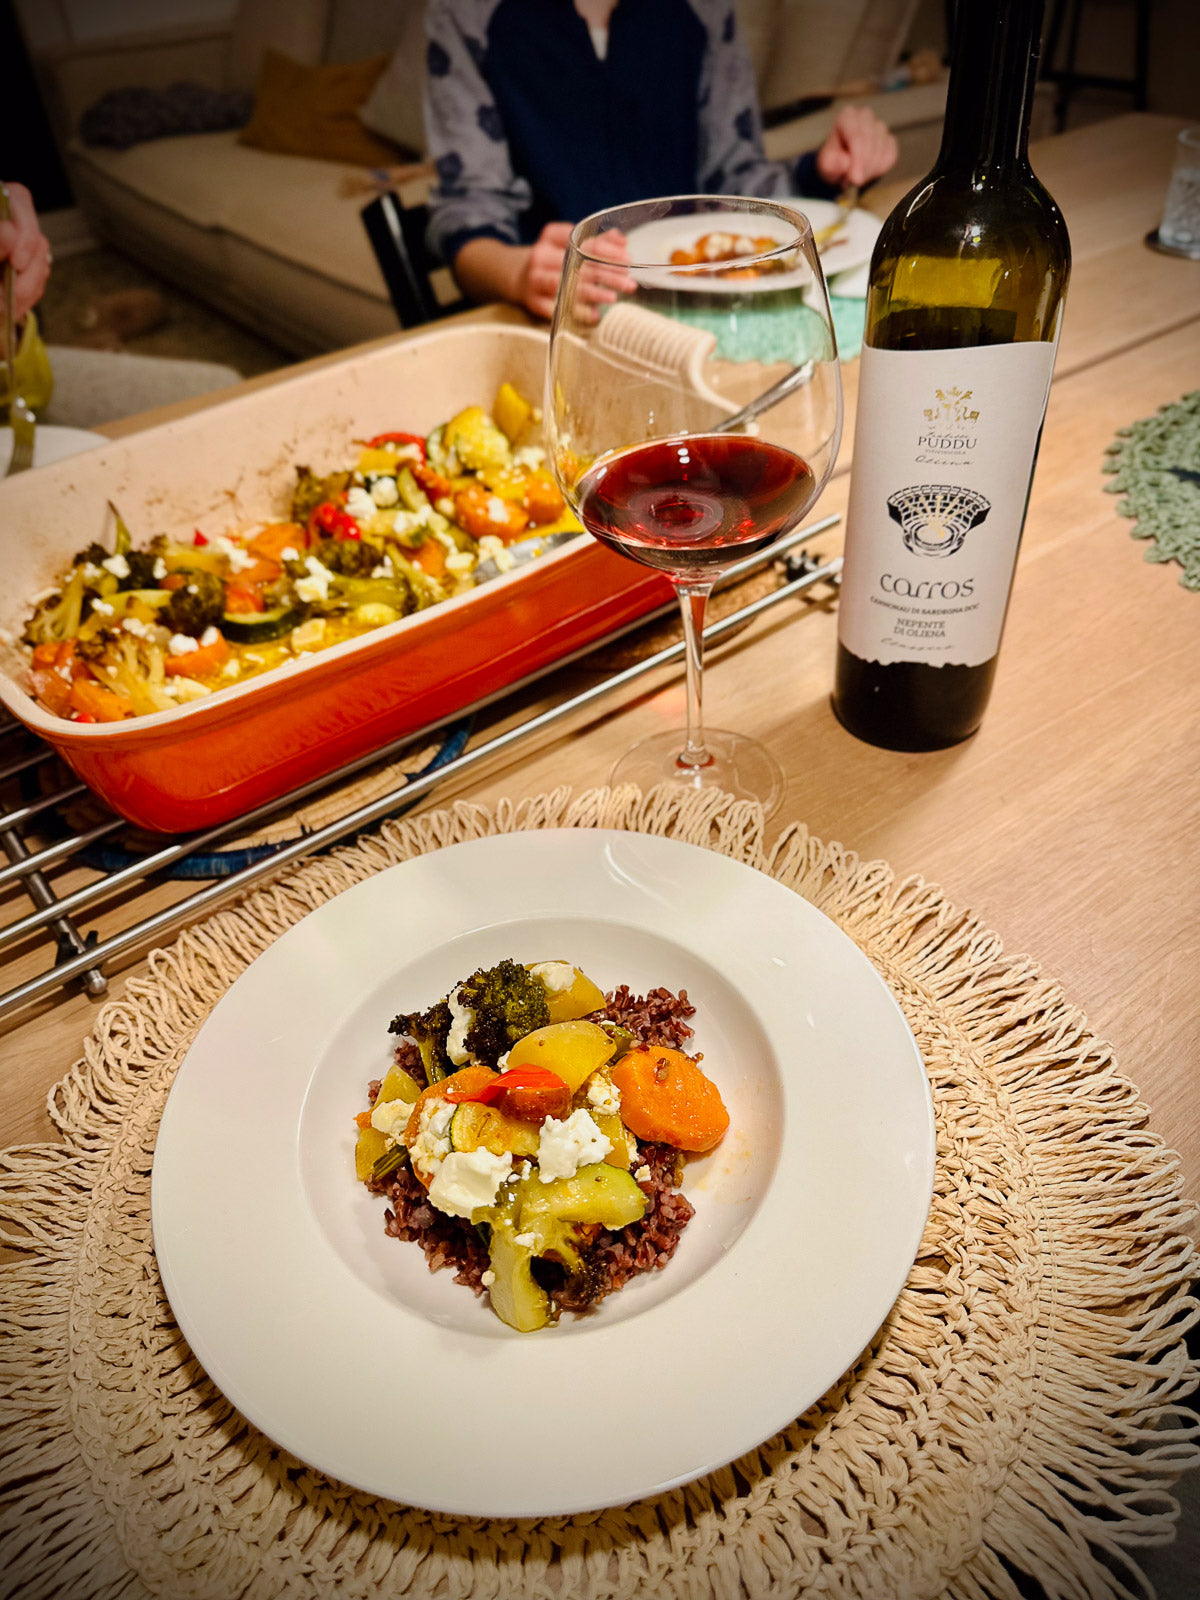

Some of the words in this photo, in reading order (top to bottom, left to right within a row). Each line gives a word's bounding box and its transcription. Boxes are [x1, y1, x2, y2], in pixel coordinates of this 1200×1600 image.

[918, 436, 977, 449] PUDDU
[897, 618, 946, 629] NEPENTE
[893, 626, 905, 636] DI
[906, 628, 946, 638] OLIENA
